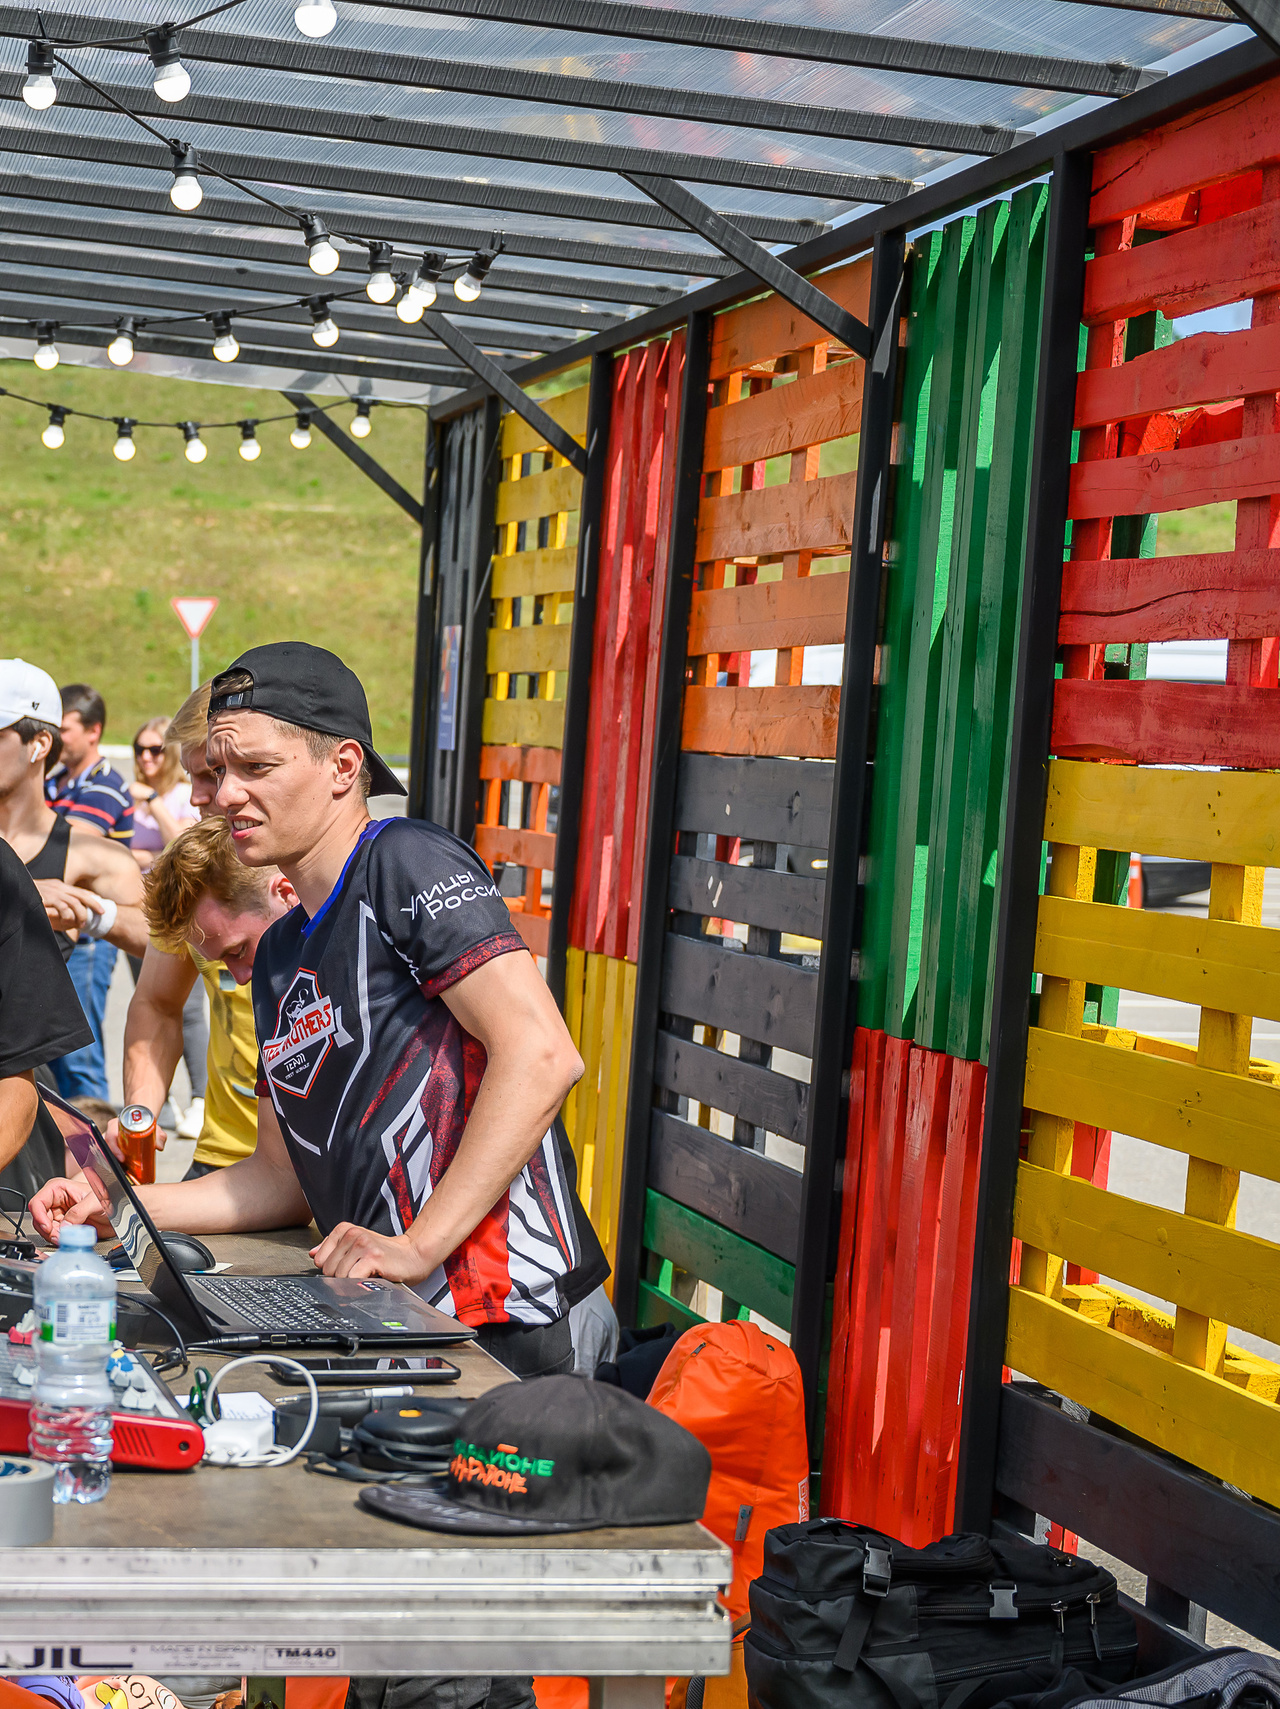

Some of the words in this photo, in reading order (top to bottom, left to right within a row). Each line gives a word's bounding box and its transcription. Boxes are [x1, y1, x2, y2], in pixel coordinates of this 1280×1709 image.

[400, 871, 475, 921] УЛИЦЫ
[283, 1053, 306, 1072] TEAM
[275, 1647, 337, 1658] TM440
